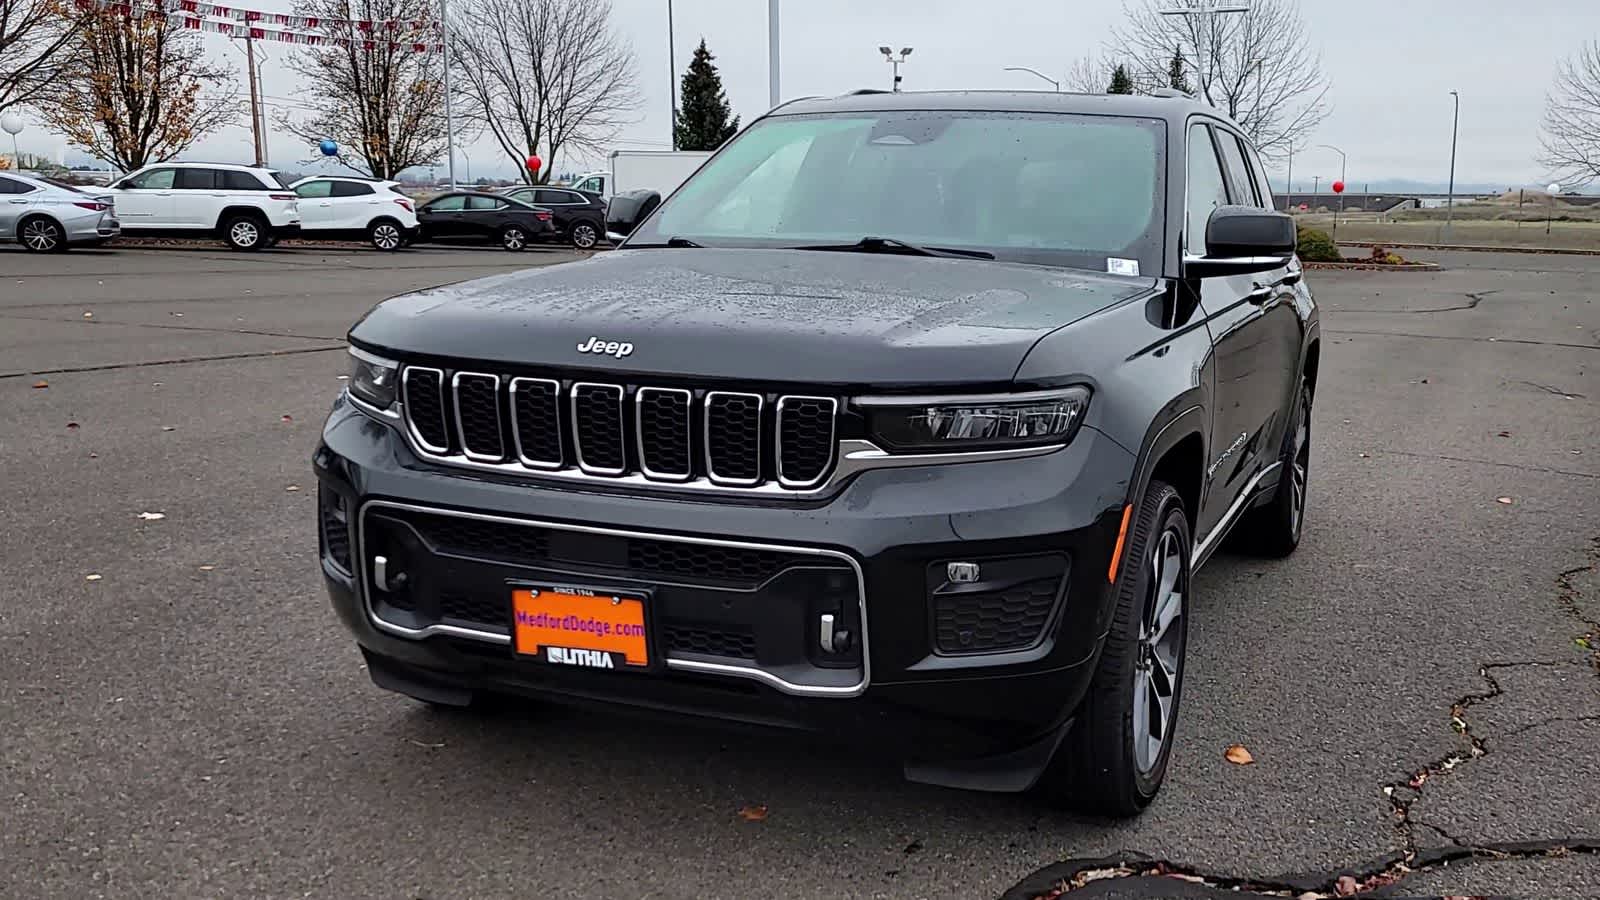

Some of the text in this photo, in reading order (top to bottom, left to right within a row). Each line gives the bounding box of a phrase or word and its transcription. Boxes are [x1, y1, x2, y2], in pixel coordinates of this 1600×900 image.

[577, 336, 634, 358] Jeep
[553, 587, 595, 597] SINCE 1946
[516, 610, 645, 637] MedfordDodge.com
[561, 648, 614, 669] LITHIA
